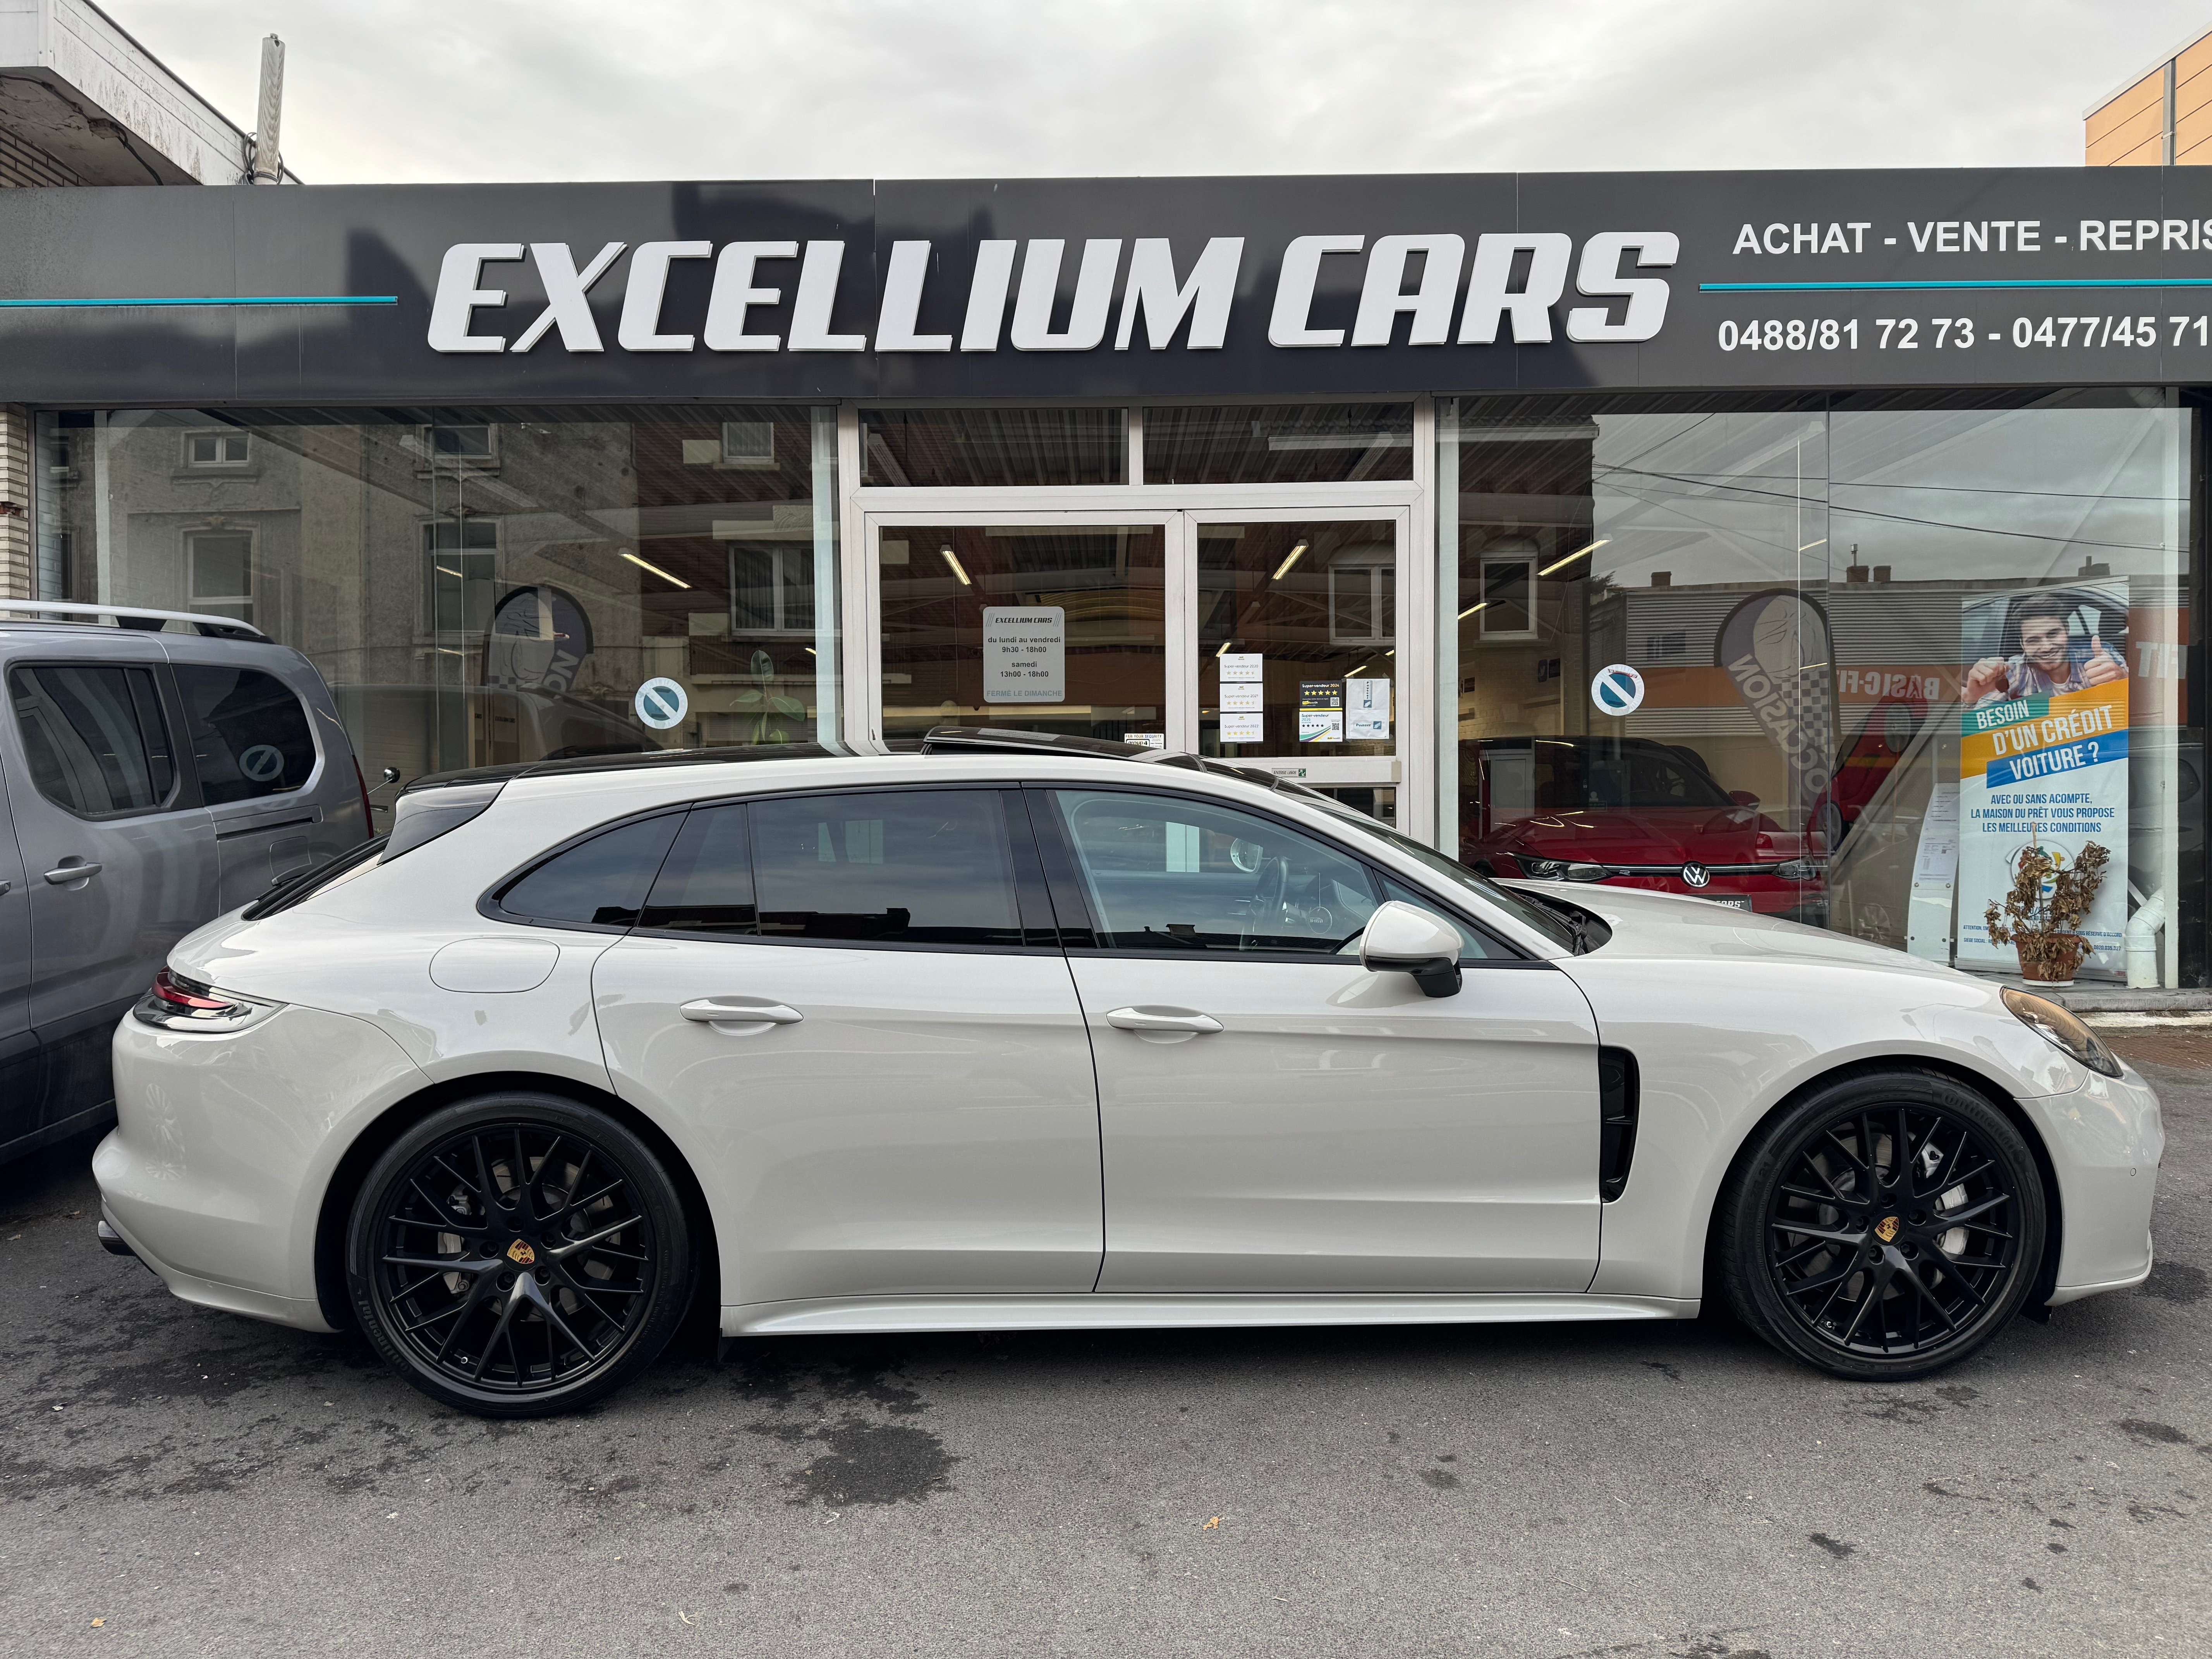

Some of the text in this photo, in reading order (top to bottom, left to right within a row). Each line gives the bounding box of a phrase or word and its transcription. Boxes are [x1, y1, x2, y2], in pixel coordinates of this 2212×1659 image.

[1733, 222, 1871, 254] ACHAT
[1907, 221, 2040, 252] VENTE
[427, 231, 1680, 352] EXCELLIUM CARS
[1719, 319, 1858, 351] 0488/81
[1876, 318, 1918, 349] 72
[1932, 318, 1975, 349] 73
[2013, 316, 2157, 348] 0477/45
[2169, 316, 2207, 346] 71
[1976, 699, 2030, 730] BESOIN
[1992, 705, 2112, 756] D'UN CRÉDIT
[2009, 742, 2099, 780] VOITURE ?
[1971, 806, 2115, 818] LA MAISON DU PRÊT VOUS PROPOSE
[1991, 793, 2092, 805] AVEC OU SANS ACOMPTE,
[1982, 822, 1997, 832] LES
[2050, 822, 2102, 832] CONDITIONS
